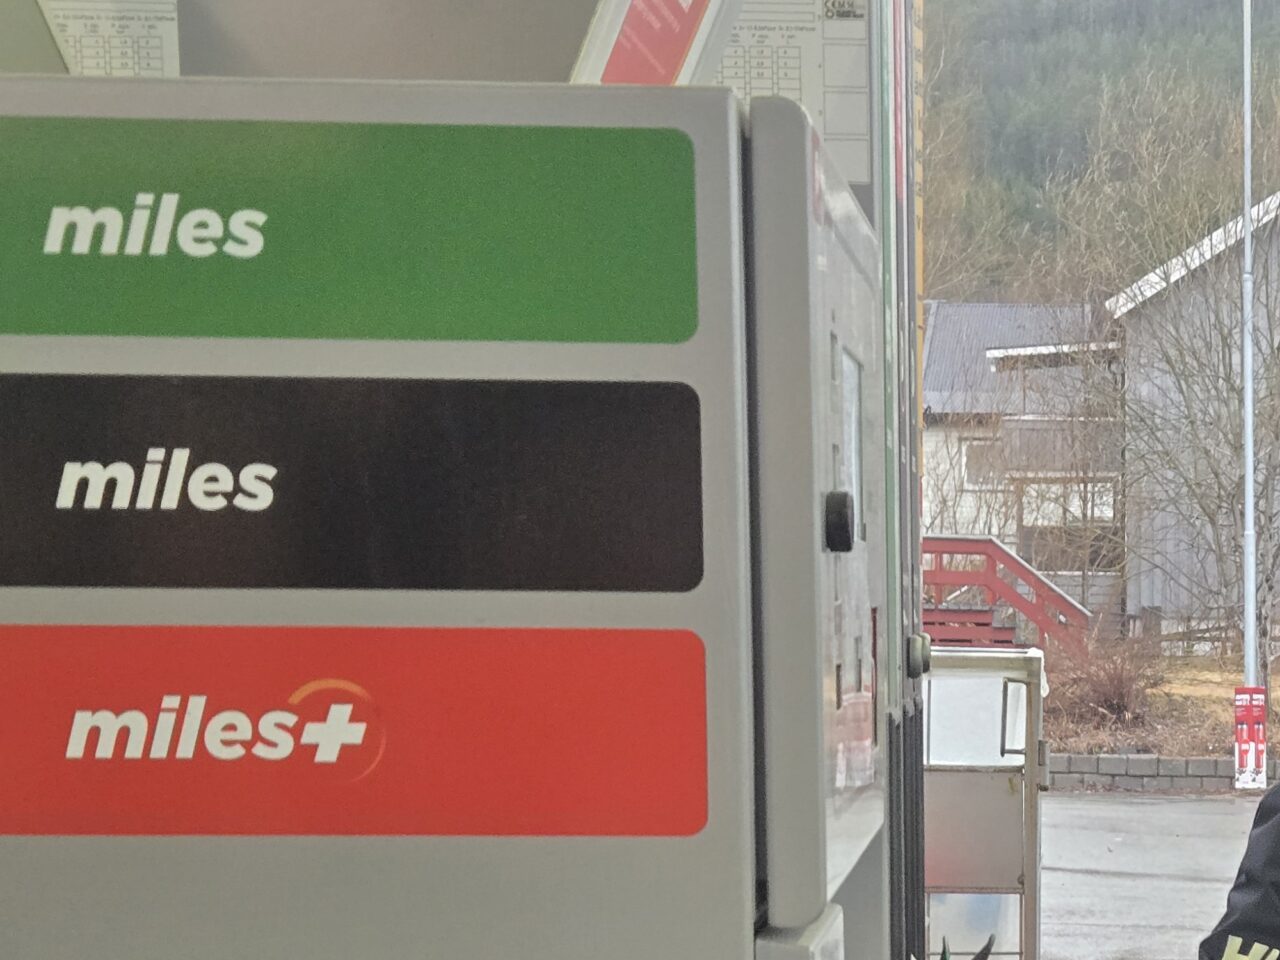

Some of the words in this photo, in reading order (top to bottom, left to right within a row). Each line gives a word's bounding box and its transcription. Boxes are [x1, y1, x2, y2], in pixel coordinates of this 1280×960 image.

[43, 193, 269, 260] miles
[55, 447, 278, 512] miles
[65, 694, 368, 763] miles+
